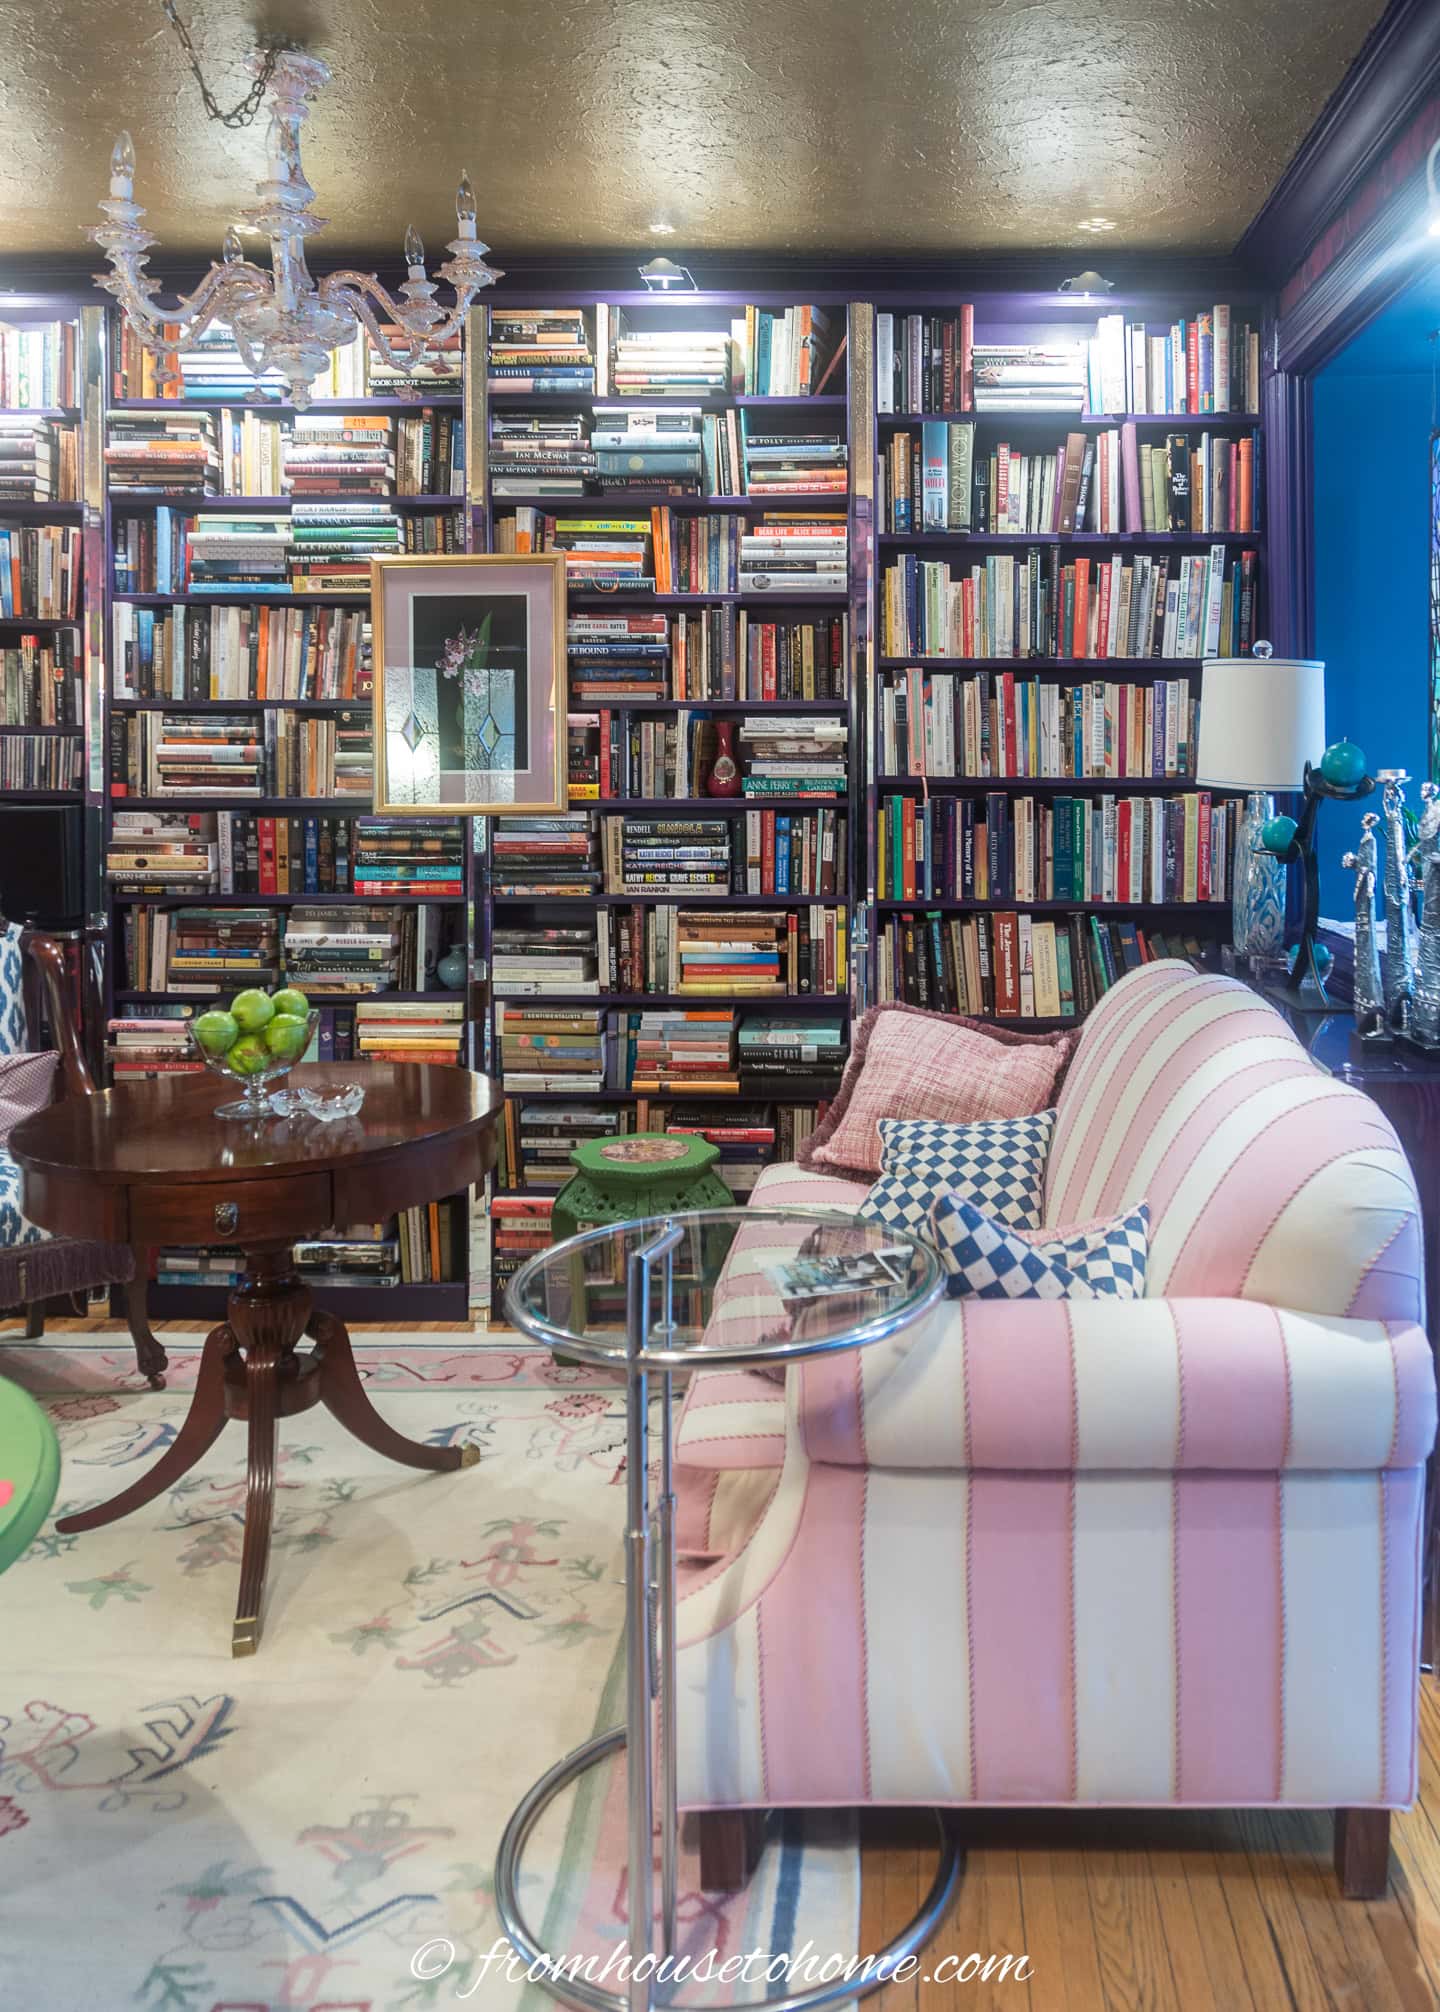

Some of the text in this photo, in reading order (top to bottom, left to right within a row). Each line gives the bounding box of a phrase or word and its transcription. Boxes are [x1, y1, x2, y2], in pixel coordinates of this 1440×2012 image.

[952, 434, 968, 517] TOM WOLFE
[746, 780, 768, 790] ANNE
[626, 825, 651, 833] RENDELL
